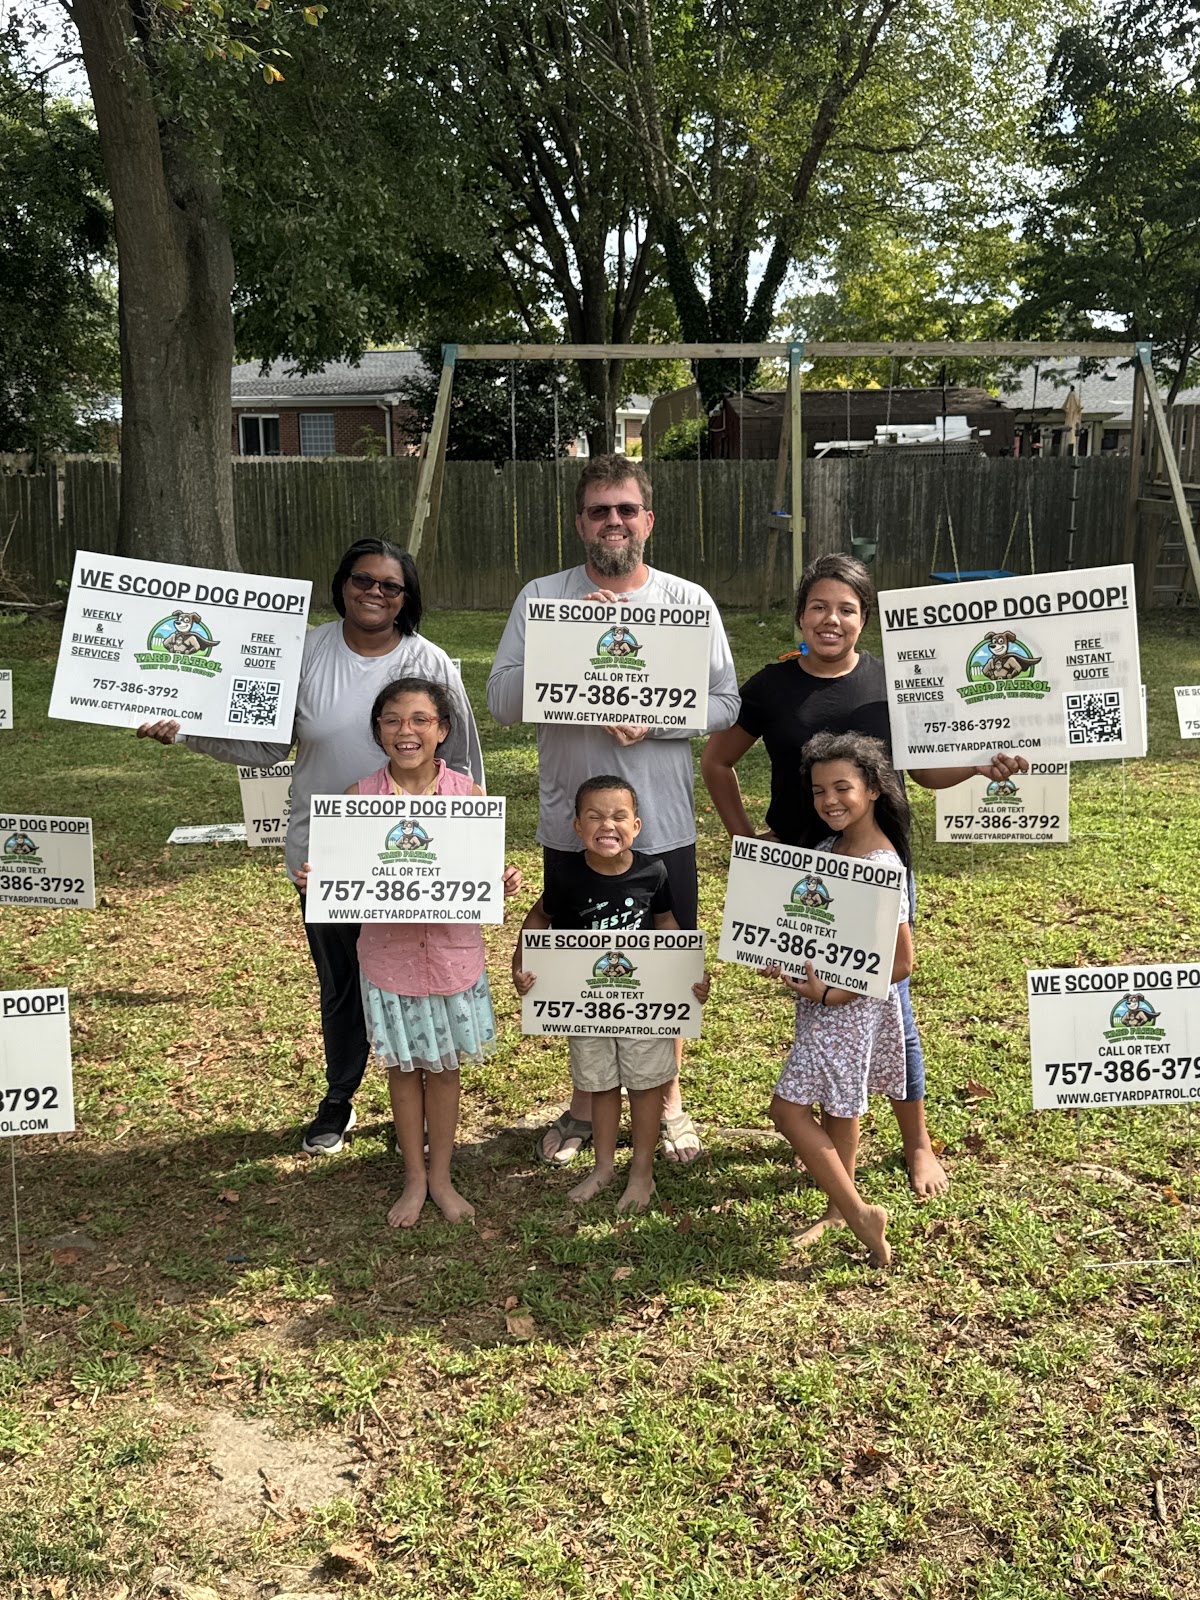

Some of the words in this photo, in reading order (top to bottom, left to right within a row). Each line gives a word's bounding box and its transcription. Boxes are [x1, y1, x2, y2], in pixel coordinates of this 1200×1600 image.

[80, 568, 114, 589] WE
[118, 575, 191, 600] SCOOP
[195, 586, 239, 605] DOG
[243, 590, 305, 612] POOP!
[885, 608, 918, 627] WE
[924, 600, 997, 624] SCOOP
[1004, 595, 1051, 616] DOG
[1058, 586, 1128, 611] POOP!
[83, 608, 122, 621] WEEKLY
[529, 604, 555, 619] WE
[559, 606, 616, 621] SCOOP
[621, 608, 656, 622] DOG
[660, 610, 710, 625] POOP!
[96, 624, 103, 632] &
[72, 633, 82, 642] BI
[84, 635, 124, 648] WEEKLY
[251, 633, 275, 642] FREE
[1074, 638, 1101, 649] FREE
[71, 647, 120, 660] SERVICES
[241, 645, 281, 656] INSTANT
[897, 649, 936, 660] WEEKLY
[134, 653, 171, 663] YARD
[173, 655, 222, 673] PATROL
[245, 658, 276, 669] QUOTE
[1066, 653, 1111, 665] INSTANT
[914, 665, 922, 674] &
[1073, 668, 1109, 679] QUOTE
[585, 672, 607, 681] CALL
[610, 673, 623, 681] OR
[626, 674, 649, 682] TEXT
[895, 680, 904, 689] BI
[905, 677, 943, 688] WEEKLY
[93, 678, 178, 699] 757-386-3792
[957, 683, 994, 698] YARD
[997, 680, 1051, 692] PATROL
[535, 683, 696, 708] 757-386-3792
[897, 691, 943, 702] SERVICES
[70, 696, 203, 720] WWW.GETYARDPATROL.COM
[544, 711, 686, 725] WWW.GETYARDPATROL.COM
[924, 718, 1010, 733] 757-386-3792
[908, 738, 1041, 754] WWW.GETYARDPATROL.COM
[240, 768, 258, 777] WE
[1031, 764, 1067, 773] POOP!
[314, 800, 341, 814] WE
[346, 800, 405, 815] SCOOP
[410, 801, 446, 815] DOG
[452, 802, 503, 816] POOP!
[20, 819, 47, 830] DOG
[51, 821, 89, 832] POOP!
[944, 815, 1059, 828] 757-386-3792
[734, 841, 758, 859] WE
[761, 846, 813, 869] SCOOP
[816, 856, 849, 877] DOG
[853, 864, 902, 887] POOP!
[372, 867, 396, 876] CALL
[400, 867, 413, 876] OR
[416, 868, 440, 877] TEXT
[0, 875, 85, 893] 386-3792
[320, 880, 491, 901] 757-386-3792
[0, 895, 78, 905] ETYARDPATROL.COM
[329, 909, 481, 919] WWW.GETYARDPATROL.COM
[592, 911, 632, 930] BEST
[776, 918, 798, 930] CALL
[801, 923, 812, 933] OR
[815, 926, 837, 938] TEXT
[525, 935, 550, 947] WE
[555, 935, 611, 947] SCOOP
[615, 935, 650, 947] DOG
[654, 935, 703, 948] POOP!
[732, 921, 880, 975] 757-386-3792
[1031, 976, 1061, 992] WE
[1065, 973, 1128, 991] SCOOP
[1134, 971, 1172, 988] DOG
[581, 991, 603, 999] CALL
[606, 991, 618, 999] OR
[4, 995, 64, 1014] POOP!
[534, 1001, 690, 1020] 757-386-3792
[542, 1024, 680, 1035] WWW.GETYARDPATROL.COM
[1099, 1046, 1125, 1056] CALL
[1127, 1046, 1141, 1055] OR
[1144, 1044, 1170, 1054] TEXT
